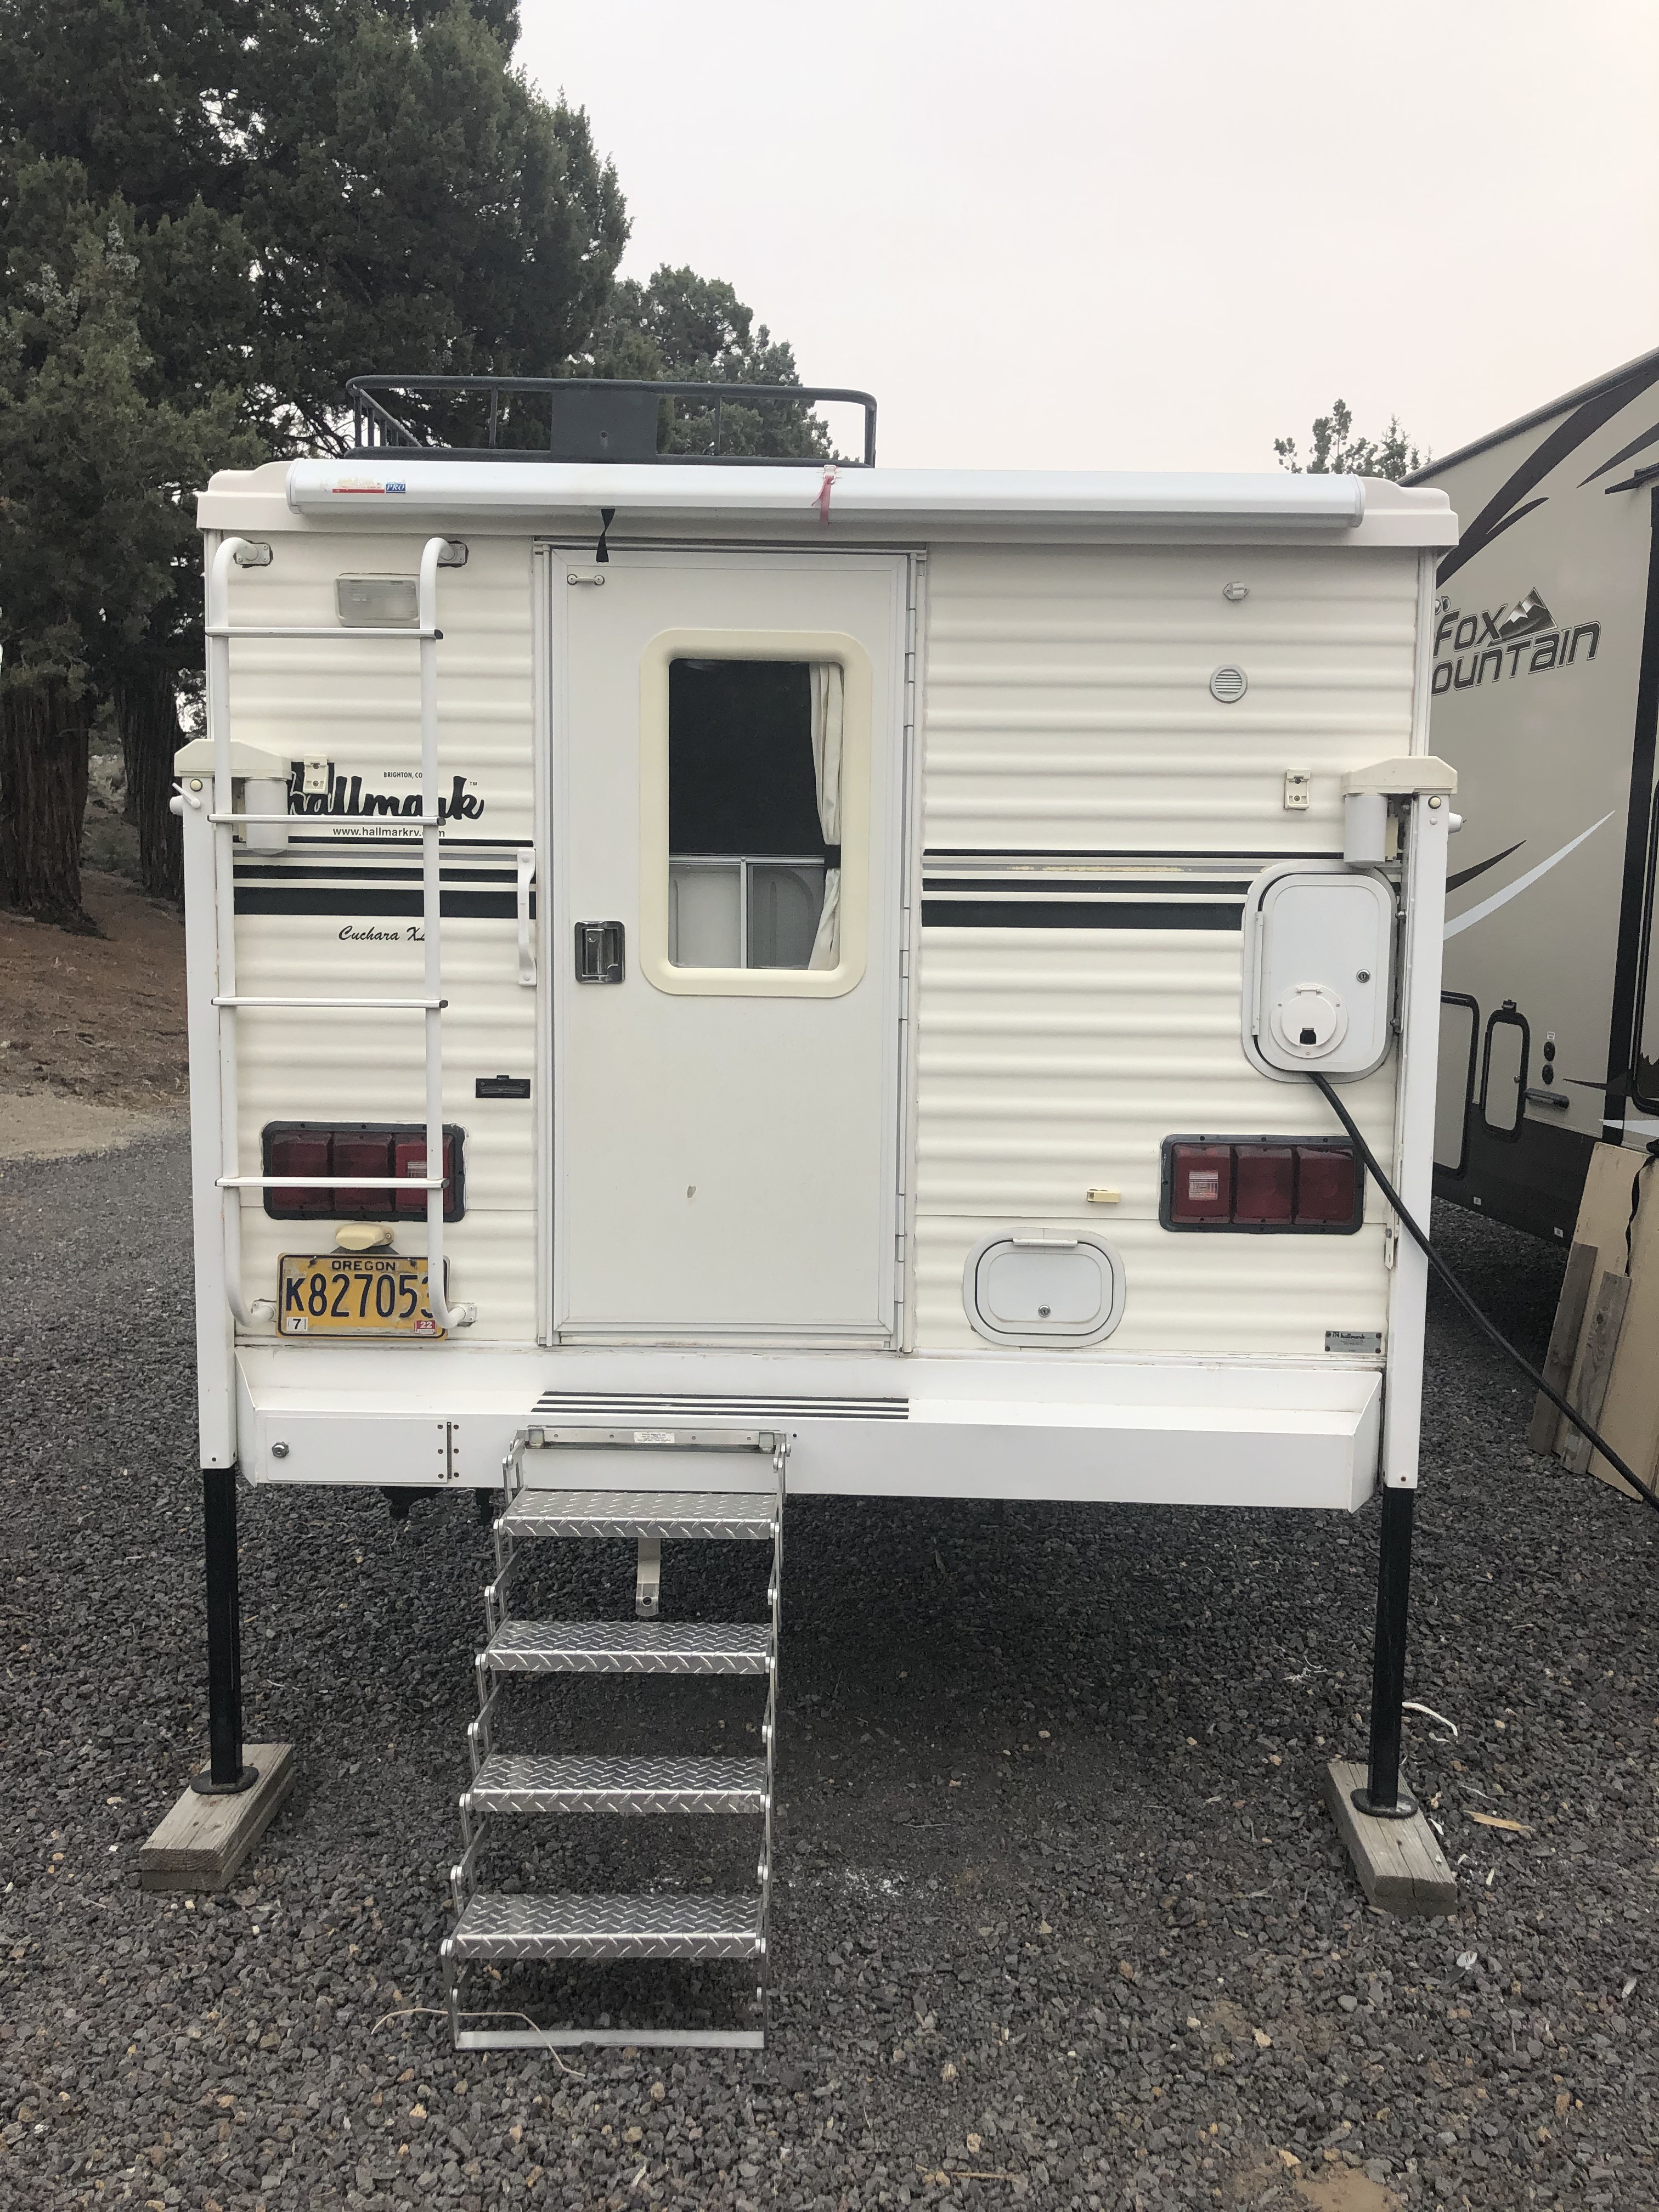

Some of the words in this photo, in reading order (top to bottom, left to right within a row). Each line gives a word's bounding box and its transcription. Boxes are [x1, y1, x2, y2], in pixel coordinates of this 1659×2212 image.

[332, 827, 445, 838] www.hallmarkrv.m
[338, 924, 400, 941] Cuchara
[331, 1260, 396, 1271] OREGON
[292, 1318, 302, 1330] 7
